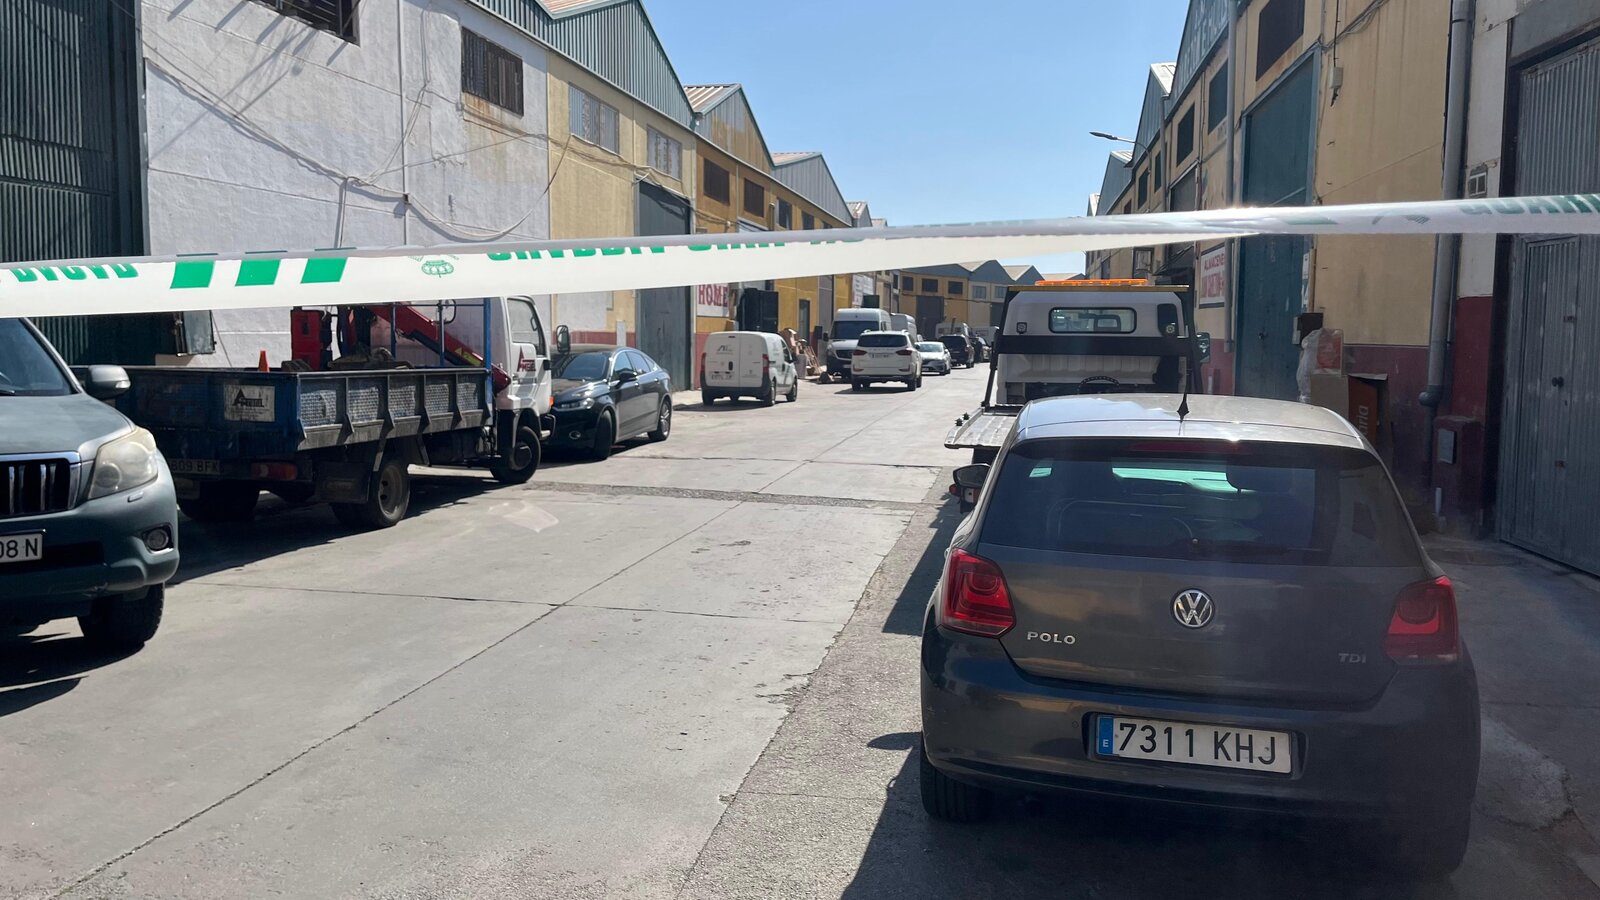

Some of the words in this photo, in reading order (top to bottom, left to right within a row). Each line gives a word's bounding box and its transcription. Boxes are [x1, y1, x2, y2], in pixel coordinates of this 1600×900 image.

[698, 284, 728, 307] HOME
[25, 538, 38, 557] N
[1026, 631, 1077, 645] POLO
[1338, 653, 1366, 665] TDI
[1102, 739, 1109, 748] E
[1118, 722, 1195, 758] 7311
[1213, 731, 1277, 766] KHJ
